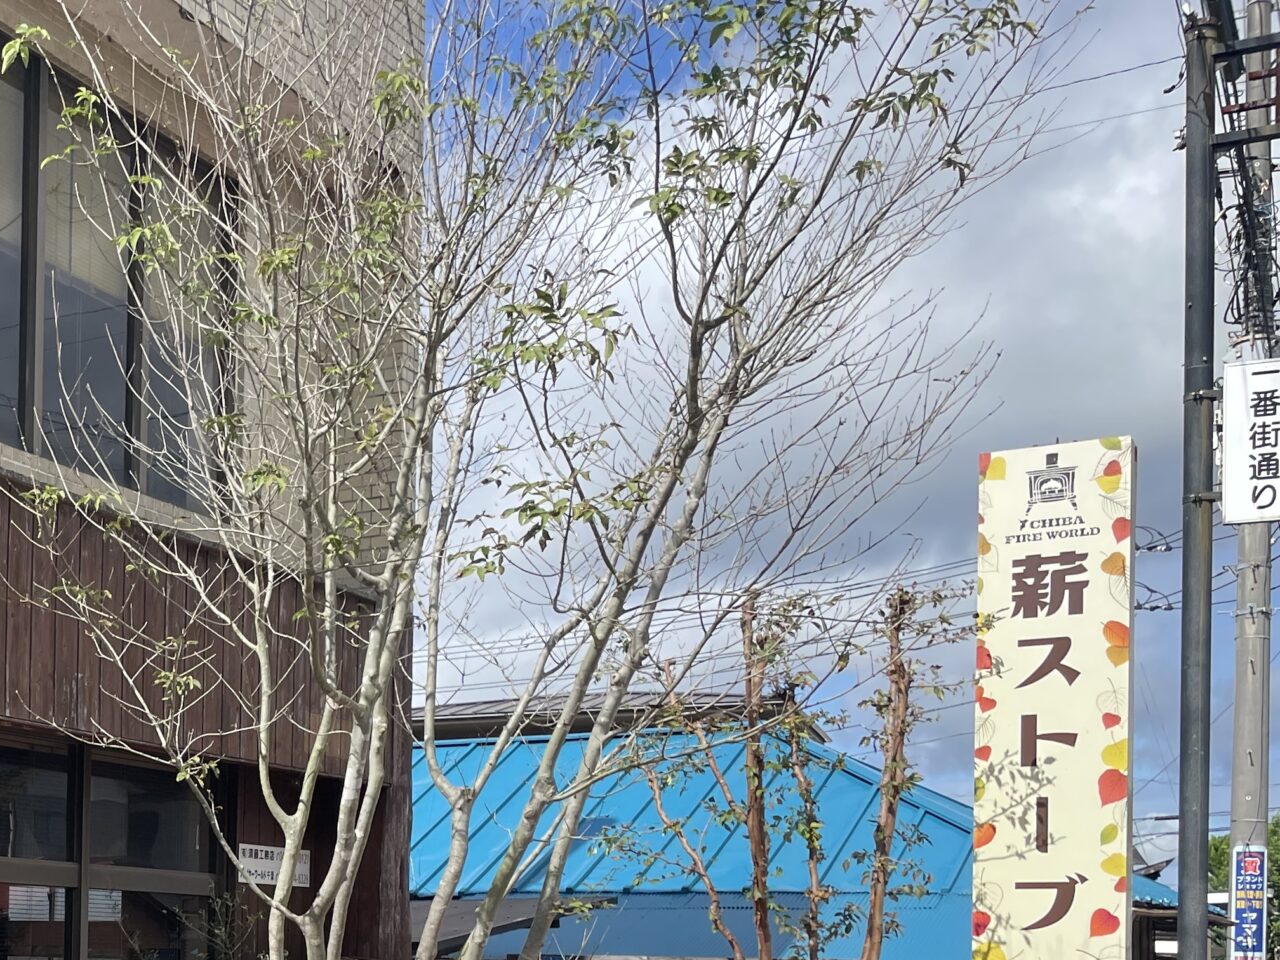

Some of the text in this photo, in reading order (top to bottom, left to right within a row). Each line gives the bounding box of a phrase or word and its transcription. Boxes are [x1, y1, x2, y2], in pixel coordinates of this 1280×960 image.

[1248, 369, 1280, 509] 一番街通り
[1004, 526, 1100, 544] FIRE WORLD
[1010, 550, 1089, 931] 薪ストーブ
